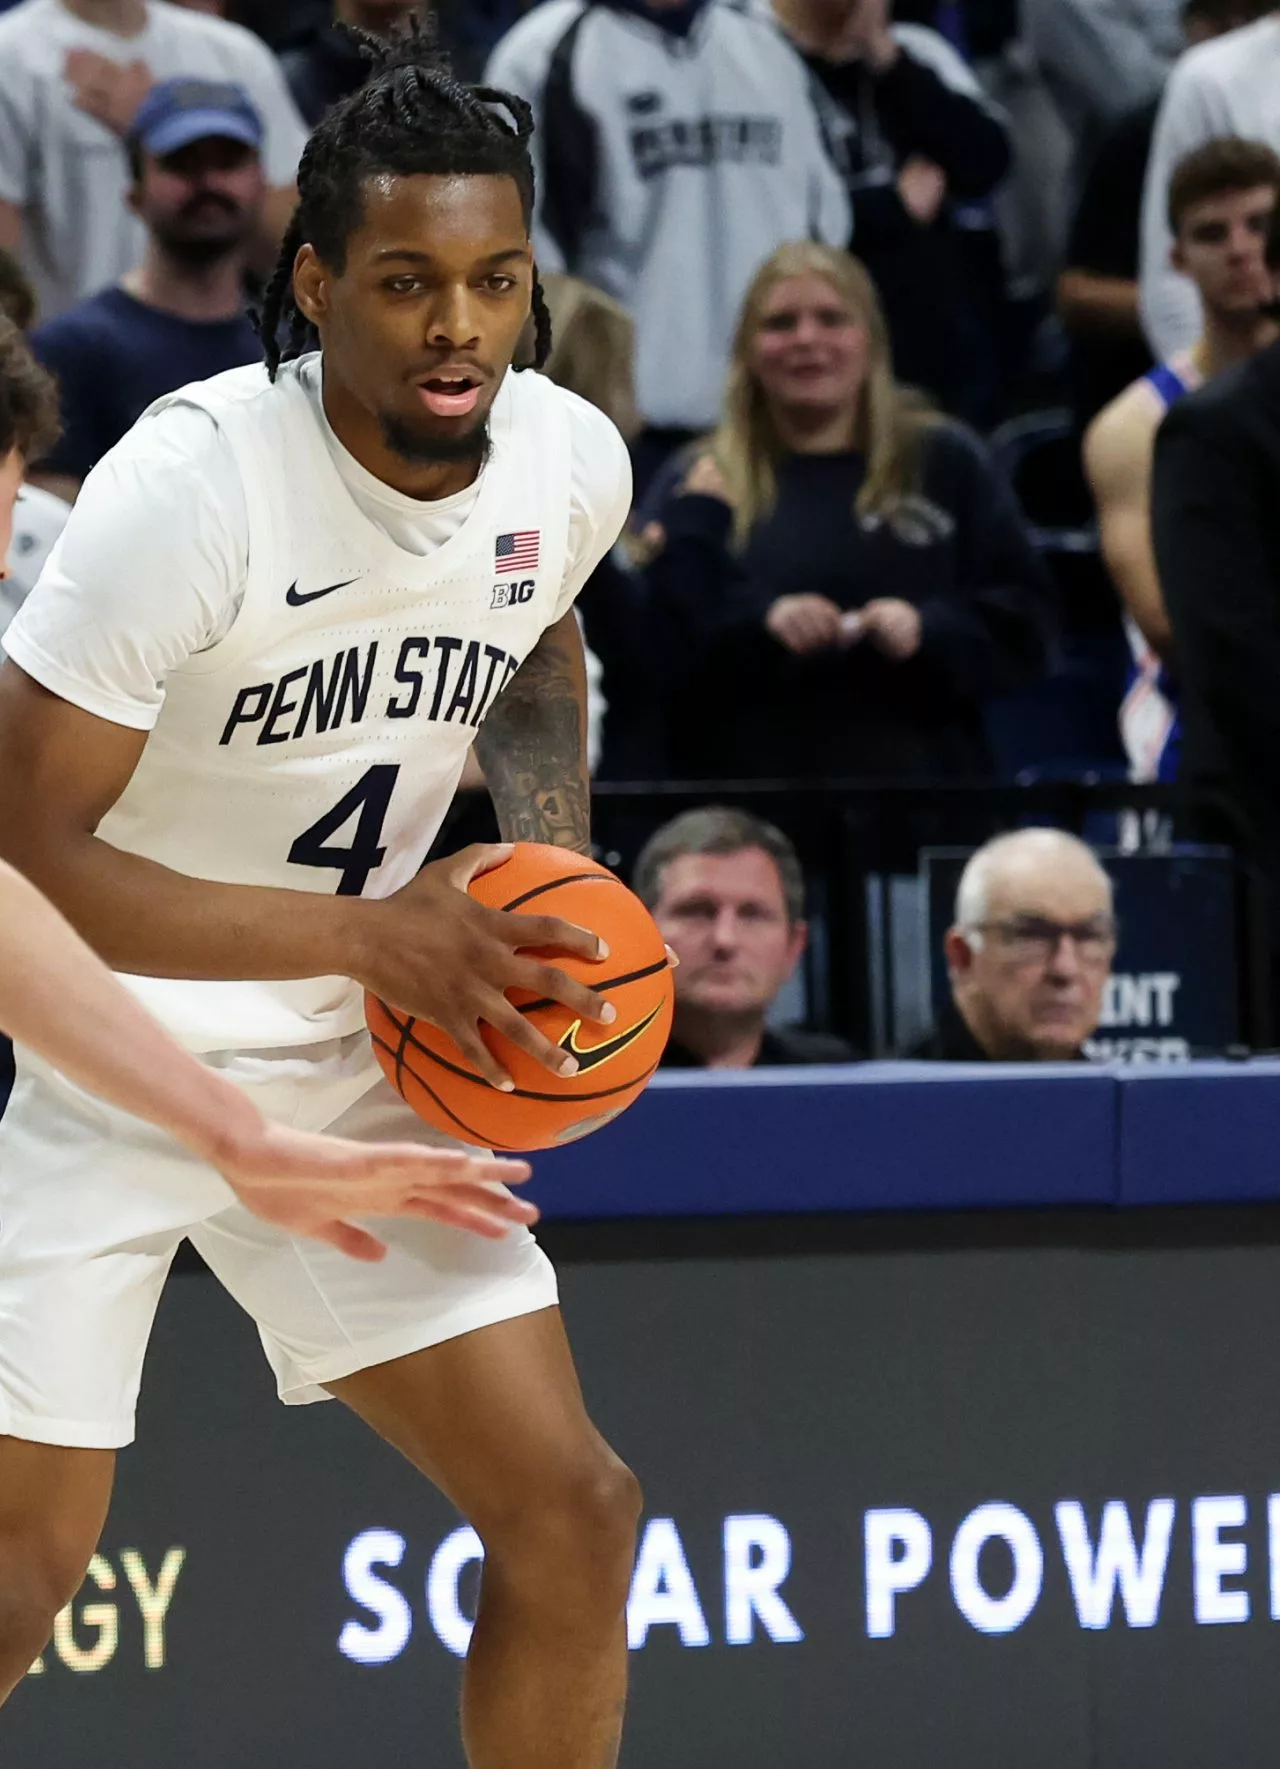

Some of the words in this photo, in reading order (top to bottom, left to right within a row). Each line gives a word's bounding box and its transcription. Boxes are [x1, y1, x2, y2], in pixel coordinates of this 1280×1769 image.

[218, 641, 379, 746] PENN
[286, 763, 401, 896] 4
[336, 1512, 807, 1668] SOAR
[864, 1491, 1280, 1638] POWE
